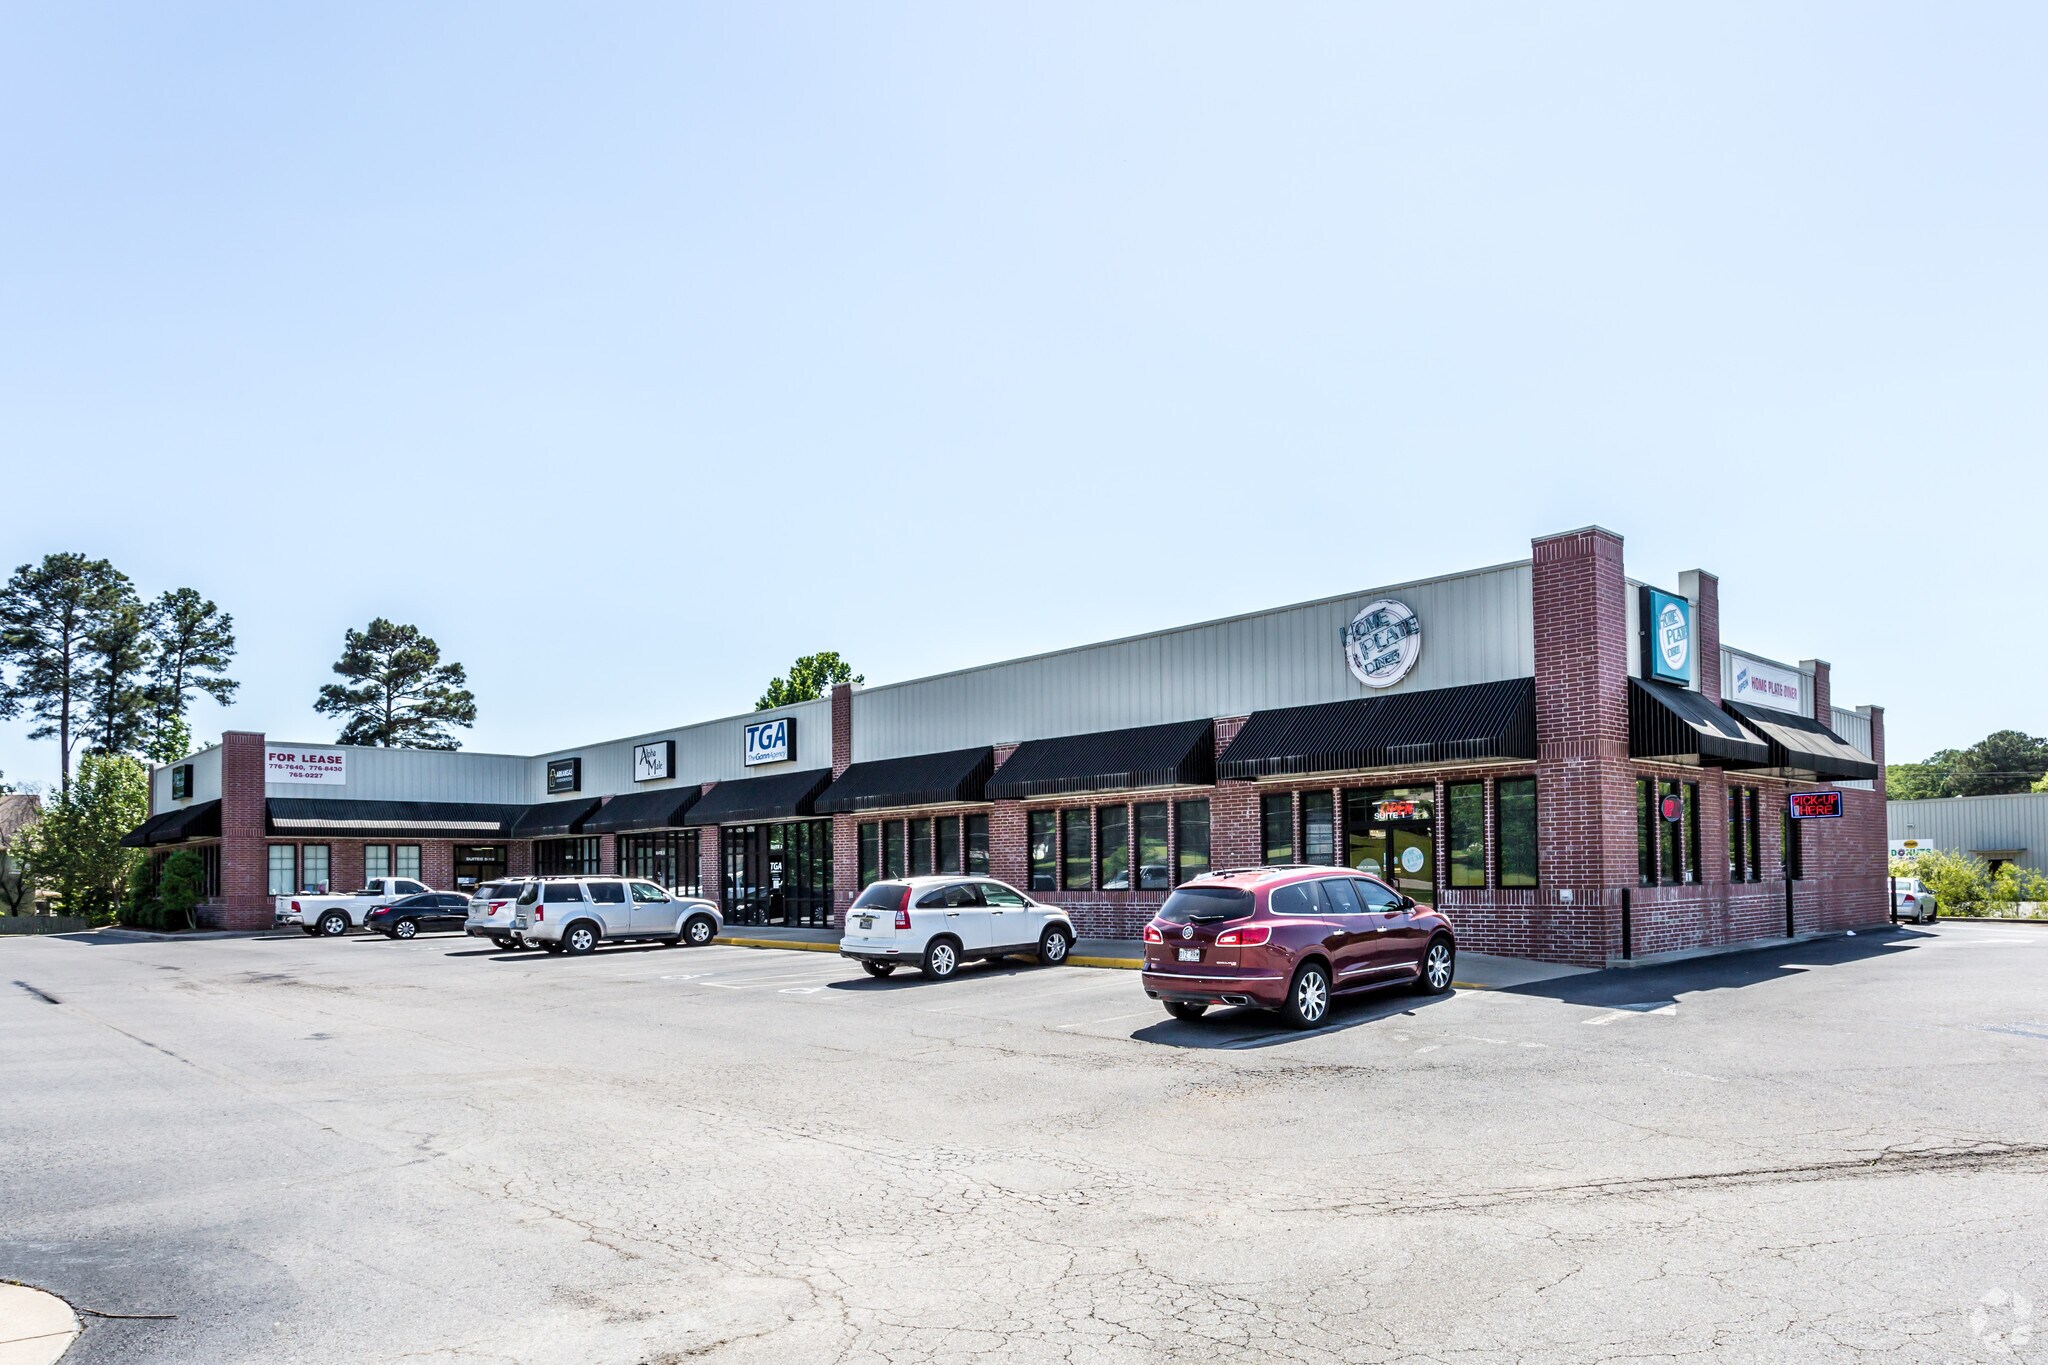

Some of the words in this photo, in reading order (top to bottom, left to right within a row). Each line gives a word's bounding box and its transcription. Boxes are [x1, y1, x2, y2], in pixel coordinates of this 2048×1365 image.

[1340, 608, 1390, 648] HOME
[1360, 617, 1420, 661] PLATE
[1364, 650, 1400, 675] DINER
[1751, 676, 1767, 692] HOME
[1768, 680, 1783, 697] PLATE
[1783, 685, 1798, 700] DINER
[747, 722, 786, 752] TGA
[268, 753, 295, 762] FOR
[302, 754, 343, 764] LEASE
[640, 746, 656, 765] Alpha
[269, 763, 306, 771] 776-7640,
[647, 759, 663, 776] Male
[1793, 794, 1838, 806] PICK-UP
[1374, 812, 1399, 820] SUITE
[1401, 811, 1406, 819] 1
[1381, 801, 1414, 816] OPEN
[1799, 805, 1833, 816] HERE
[770, 862, 783, 870] TGA
